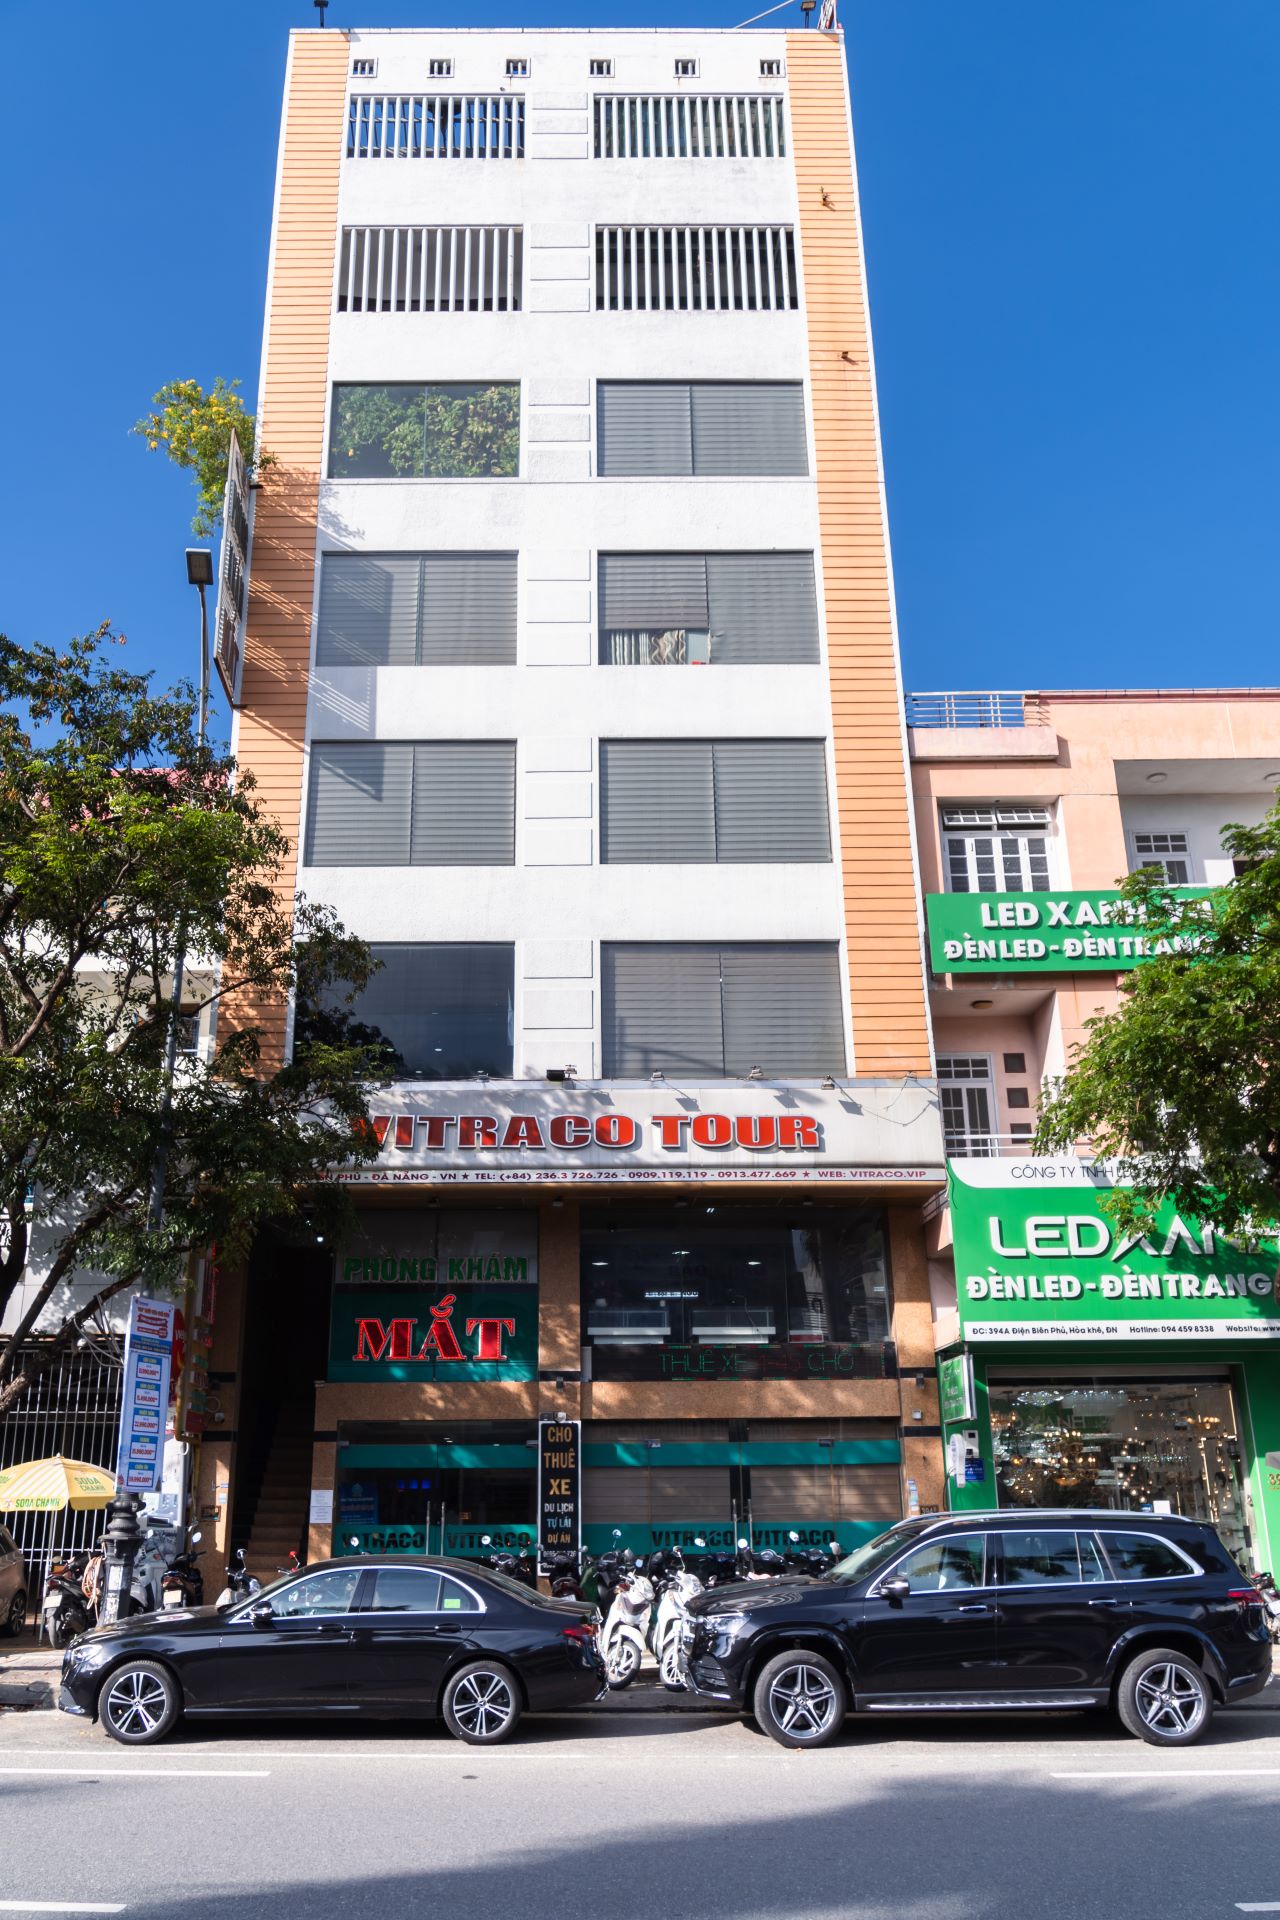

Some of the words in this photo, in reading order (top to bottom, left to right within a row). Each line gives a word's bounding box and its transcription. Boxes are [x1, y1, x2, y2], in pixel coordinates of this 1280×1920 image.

[981, 902, 1040, 929] LED
[651, 1114, 820, 1149] TOUR
[500, 1172, 531, 1181] (+84)
[628, 1171, 708, 1179] 0909.119.119
[818, 1170, 846, 1178] WEB:
[850, 1170, 927, 1178] VITRACO.VIP
[1011, 1164, 1056, 1179] CÔNG
[1060, 1166, 1076, 1178] TY
[1081, 1166, 1113, 1178] TNHH
[989, 1214, 1111, 1258] LED
[447, 1251, 528, 1282] KHÁM
[1163, 1272, 1273, 1297] TRANG
[352, 1294, 516, 1361] MẮT
[1106, 1326, 1118, 1334] ĐN
[1161, 1325, 1176, 1333] 094
[1178, 1325, 1193, 1333] 459
[1195, 1325, 1214, 1333] 8338
[1226, 1325, 1261, 1333] Website:
[548, 1426, 573, 1443] CHO
[543, 1447, 576, 1469] THUÊ
[549, 1478, 571, 1495] XE
[544, 1503, 555, 1512] DU
[557, 1503, 574, 1514] LỊCH
[342, 1532, 426, 1549] VTRACO
